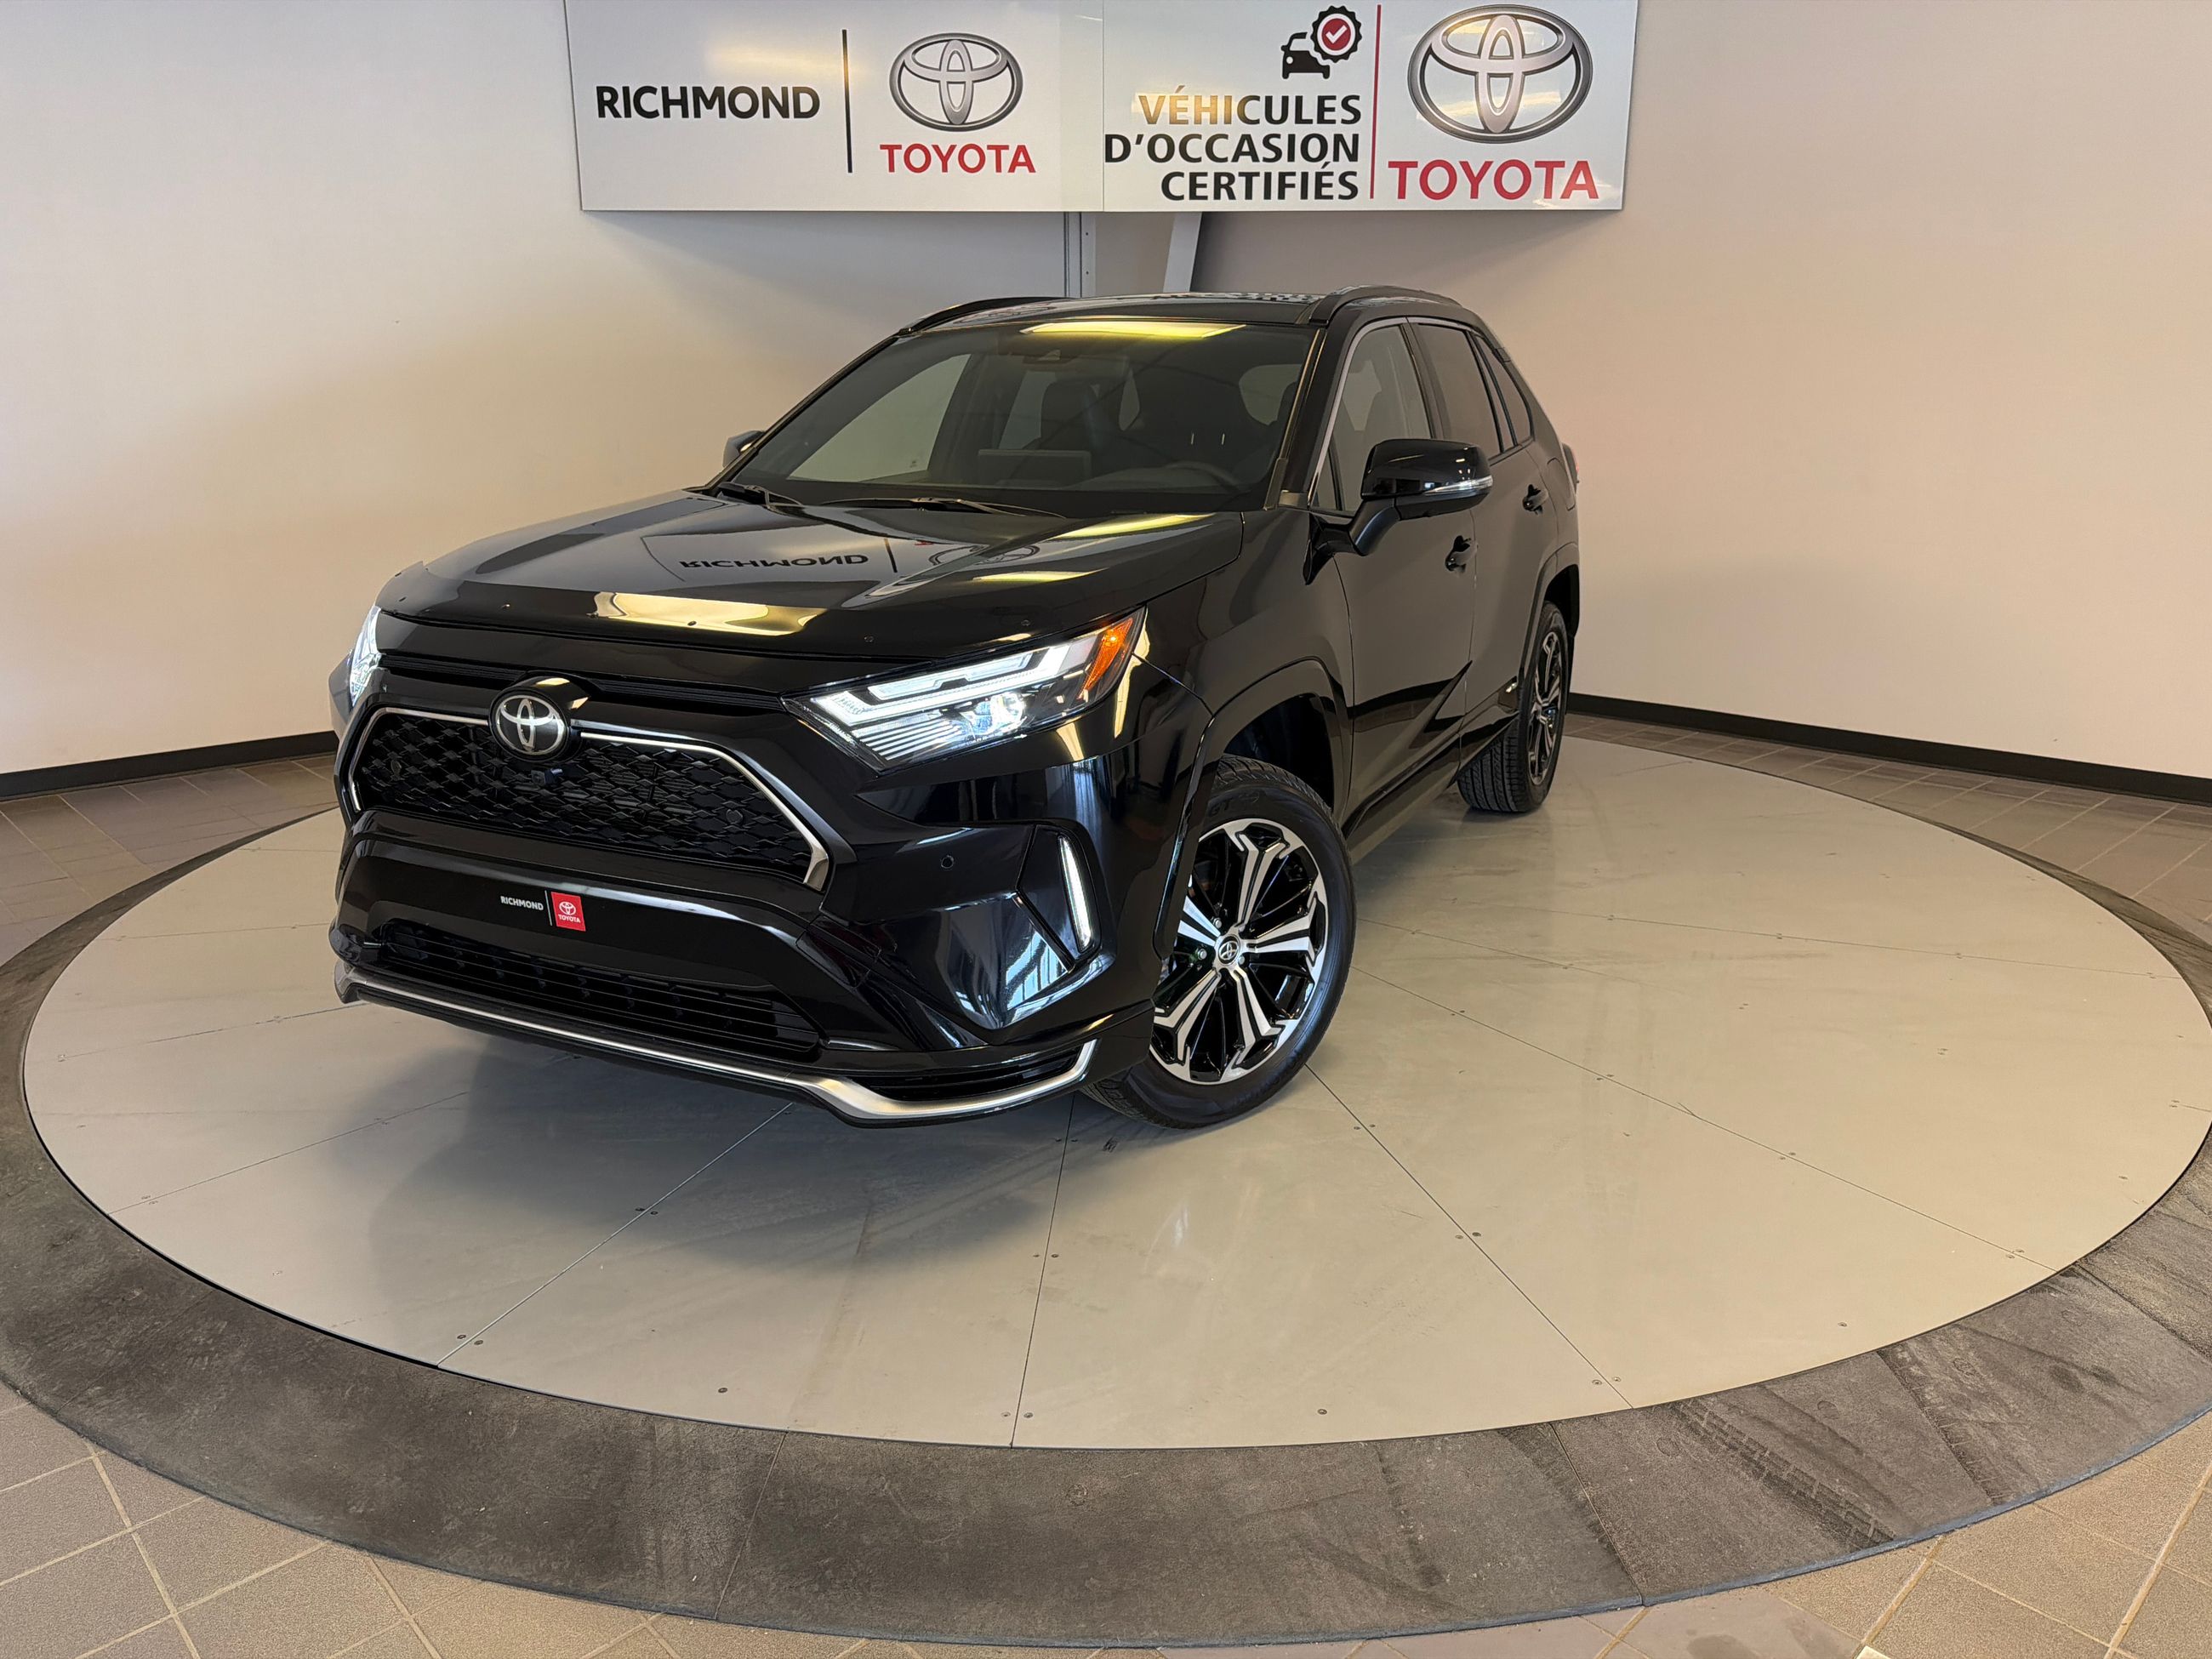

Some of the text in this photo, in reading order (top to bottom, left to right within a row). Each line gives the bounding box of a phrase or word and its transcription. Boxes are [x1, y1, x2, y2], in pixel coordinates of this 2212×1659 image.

[596, 85, 820, 119] RICHMOND
[1138, 86, 1361, 125] VÉHICULES
[880, 143, 1035, 174] TOYOTA
[1104, 133, 1360, 163] D'OCCASION
[1161, 162, 1359, 202] CERTIFIÉS
[1388, 159, 1599, 201] TOYOTA
[500, 895, 544, 911] RICHMOND
[558, 913, 581, 923] TOYOTA
